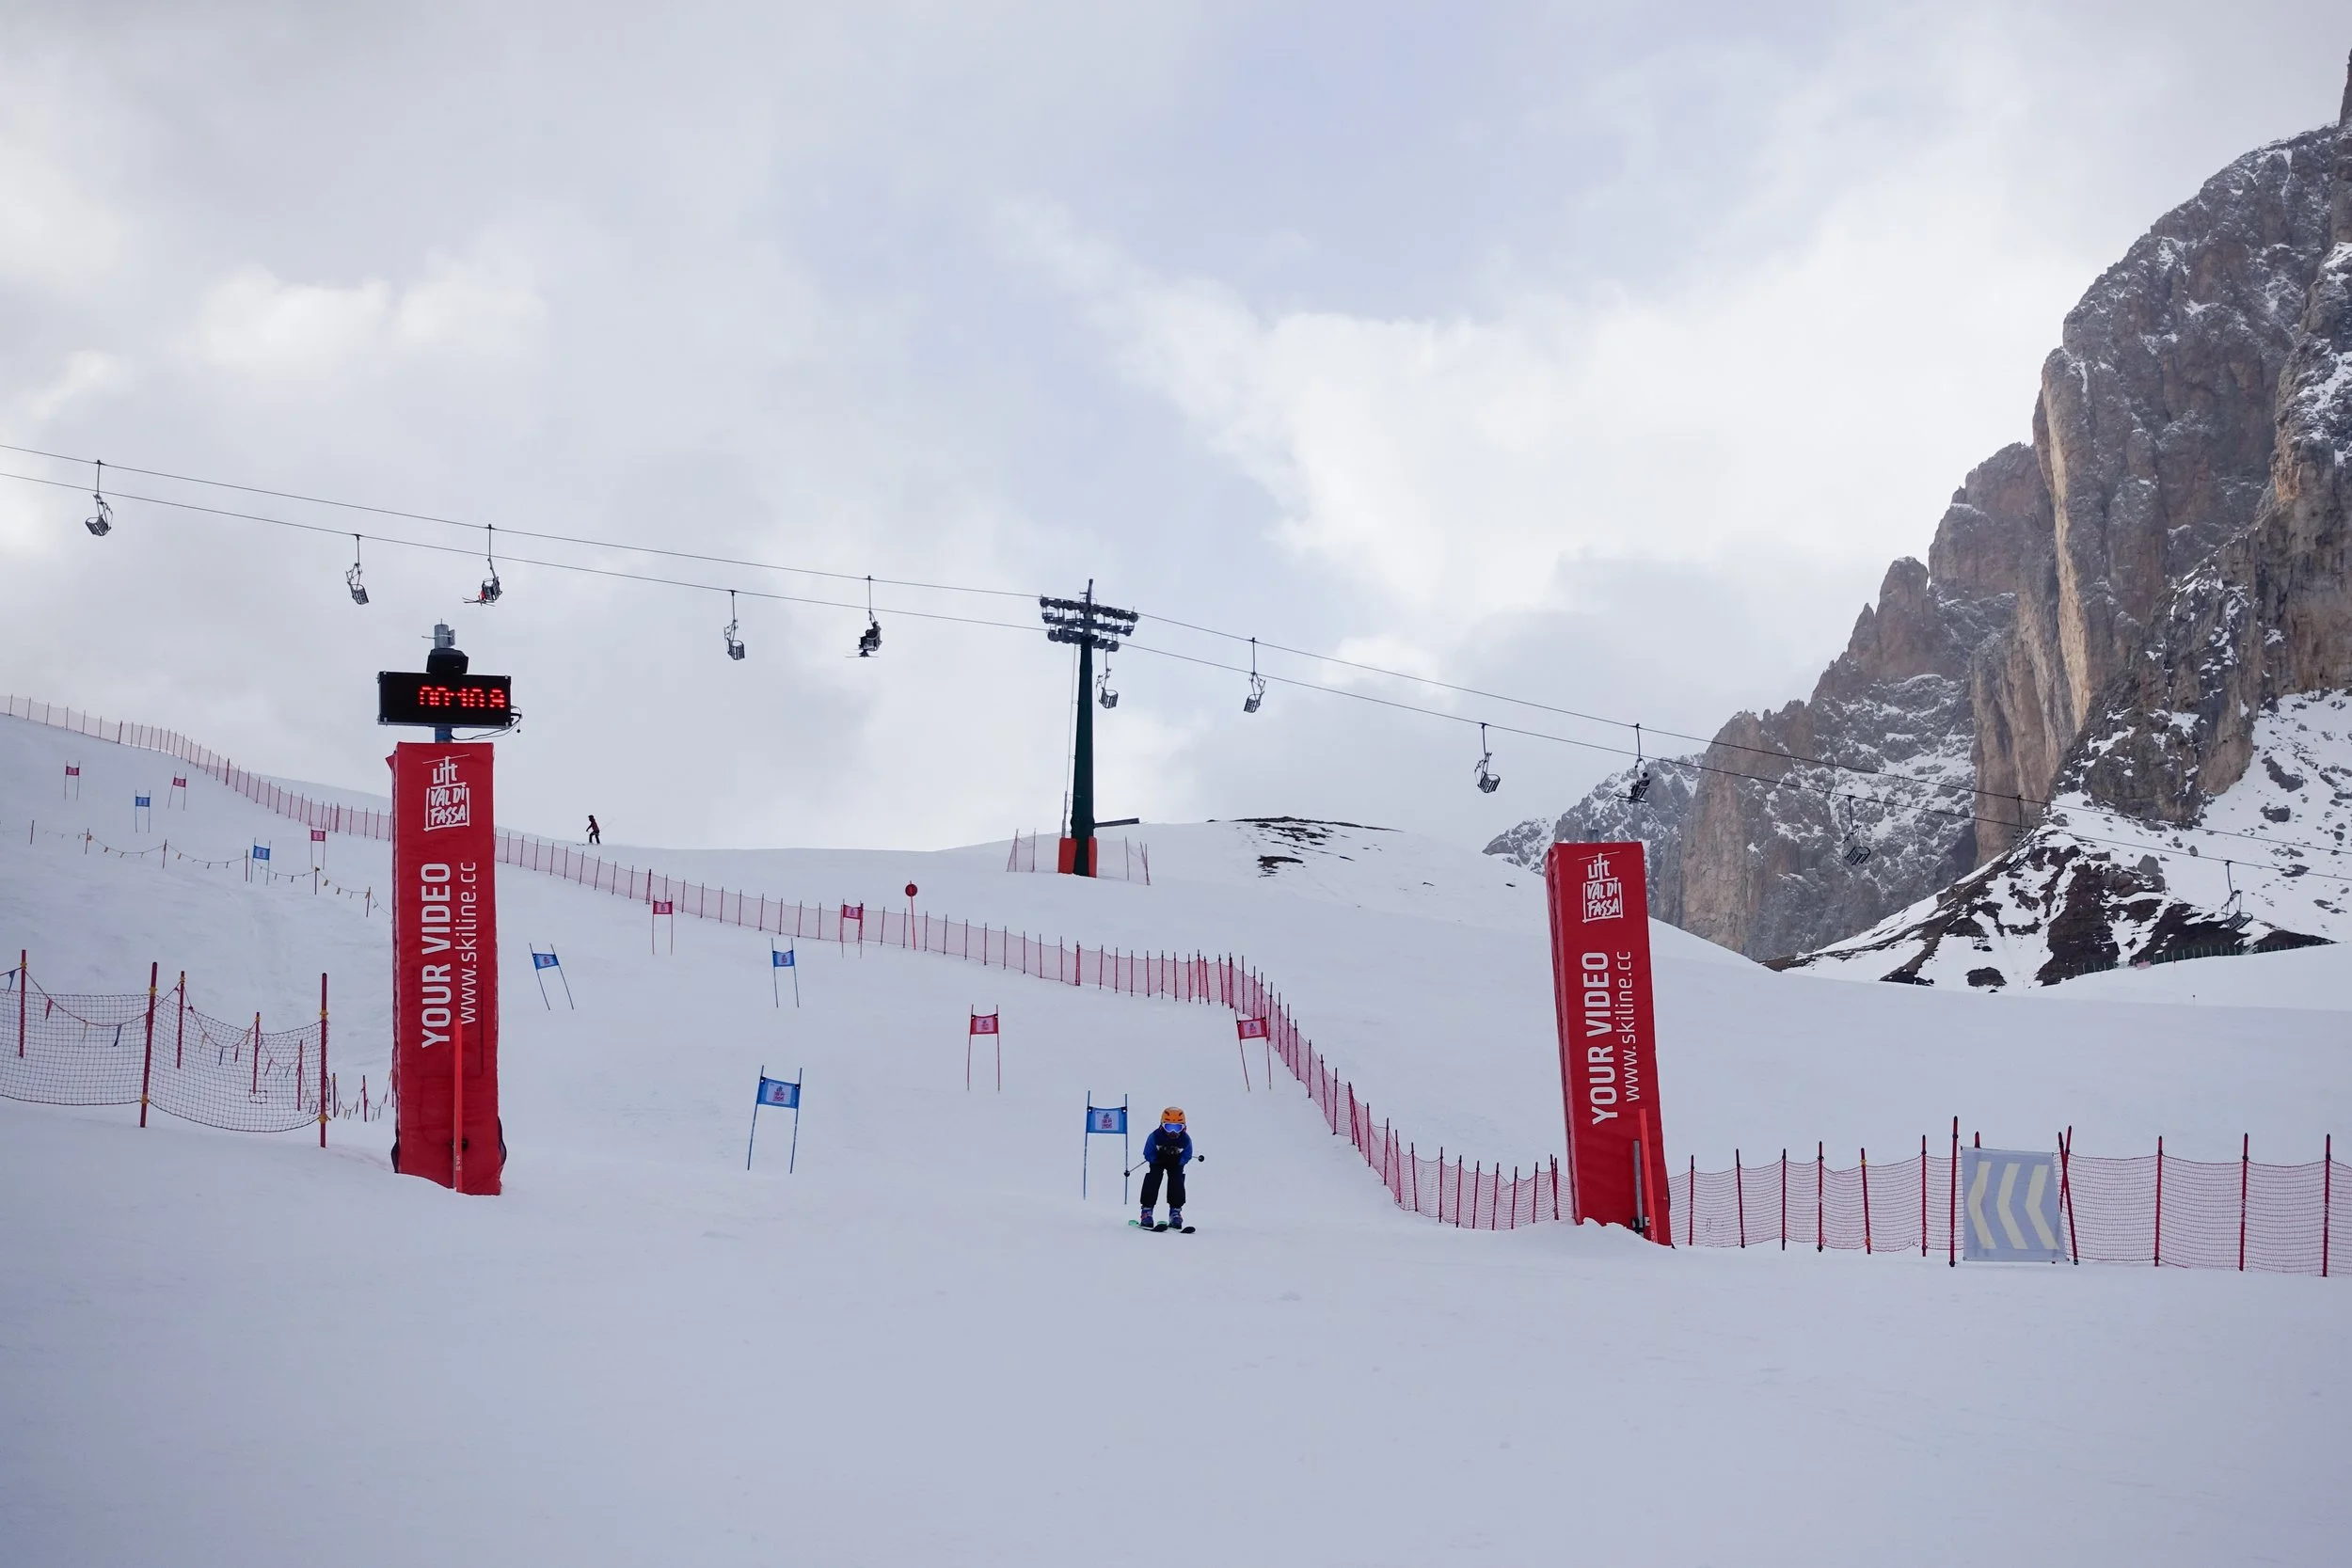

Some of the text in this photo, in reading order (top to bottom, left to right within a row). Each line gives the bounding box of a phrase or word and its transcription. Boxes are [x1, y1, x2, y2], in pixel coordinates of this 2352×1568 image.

[430, 804, 467, 826] FASSA
[431, 786, 451, 806] VAL
[1586, 881, 1606, 900] VAL
[1586, 897, 1619, 918] FASSA
[421, 863, 452, 1049] YOUR VIDEO
[455, 862, 477, 1025] www.skiline.cc
[1581, 952, 1618, 1125] YOUR VIDEO
[1614, 951, 1641, 1102] www.skiline.cc
